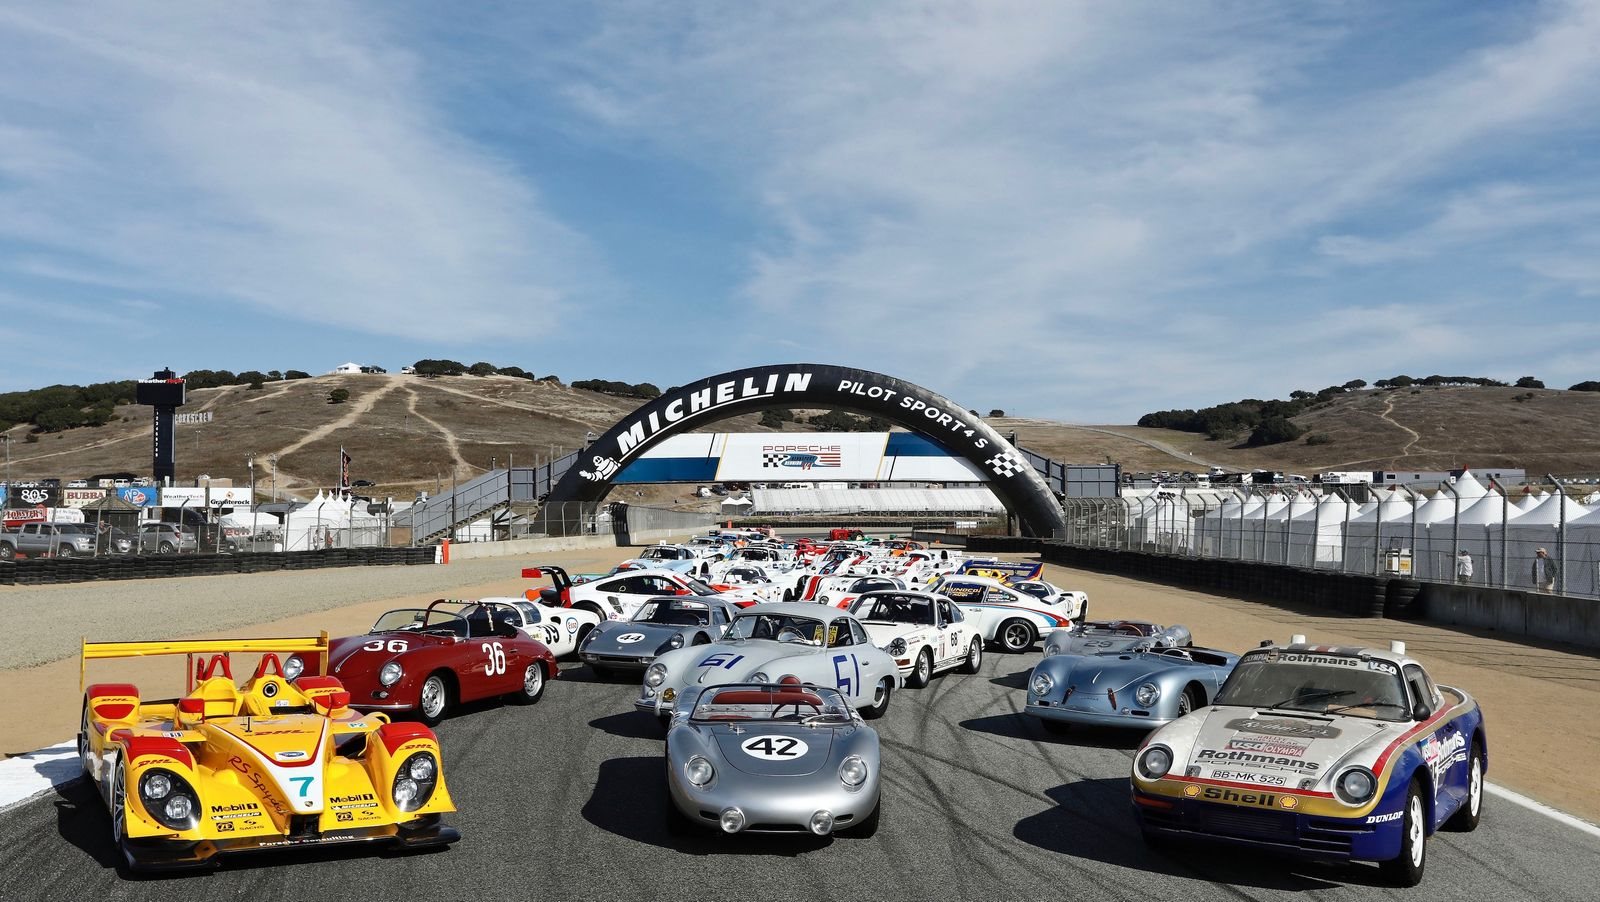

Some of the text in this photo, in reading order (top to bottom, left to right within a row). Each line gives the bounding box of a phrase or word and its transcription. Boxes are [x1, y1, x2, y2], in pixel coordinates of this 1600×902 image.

[175, 411, 213, 425] CORKSCREW
[616, 373, 813, 456] MICHELIN
[837, 379, 988, 449] PILOT SPORT 4 S
[21, 489, 49, 501] 805
[66, 491, 104, 500] BUBBA
[363, 639, 410, 654] 36
[481, 641, 507, 677] 36
[698, 652, 745, 670] 61
[1277, 653, 1358, 667] Rothmans
[832, 654, 861, 697] 61
[745, 737, 799, 757] 42
[1265, 745, 1303, 758] OLYMPIA
[137, 758, 173, 768] DHL
[228, 756, 252, 774] RS
[1194, 759, 1316, 777] PORSCHE
[1198, 749, 1320, 770] Rothmans
[1212, 769, 1285, 786] BB-MK 525
[289, 776, 315, 798] 7
[330, 794, 362, 803] Mobil
[1203, 787, 1275, 807] Shell
[211, 803, 246, 813] Mobil
[1366, 810, 1404, 824] DUNLOP
[259, 839, 300, 847] Porsche
